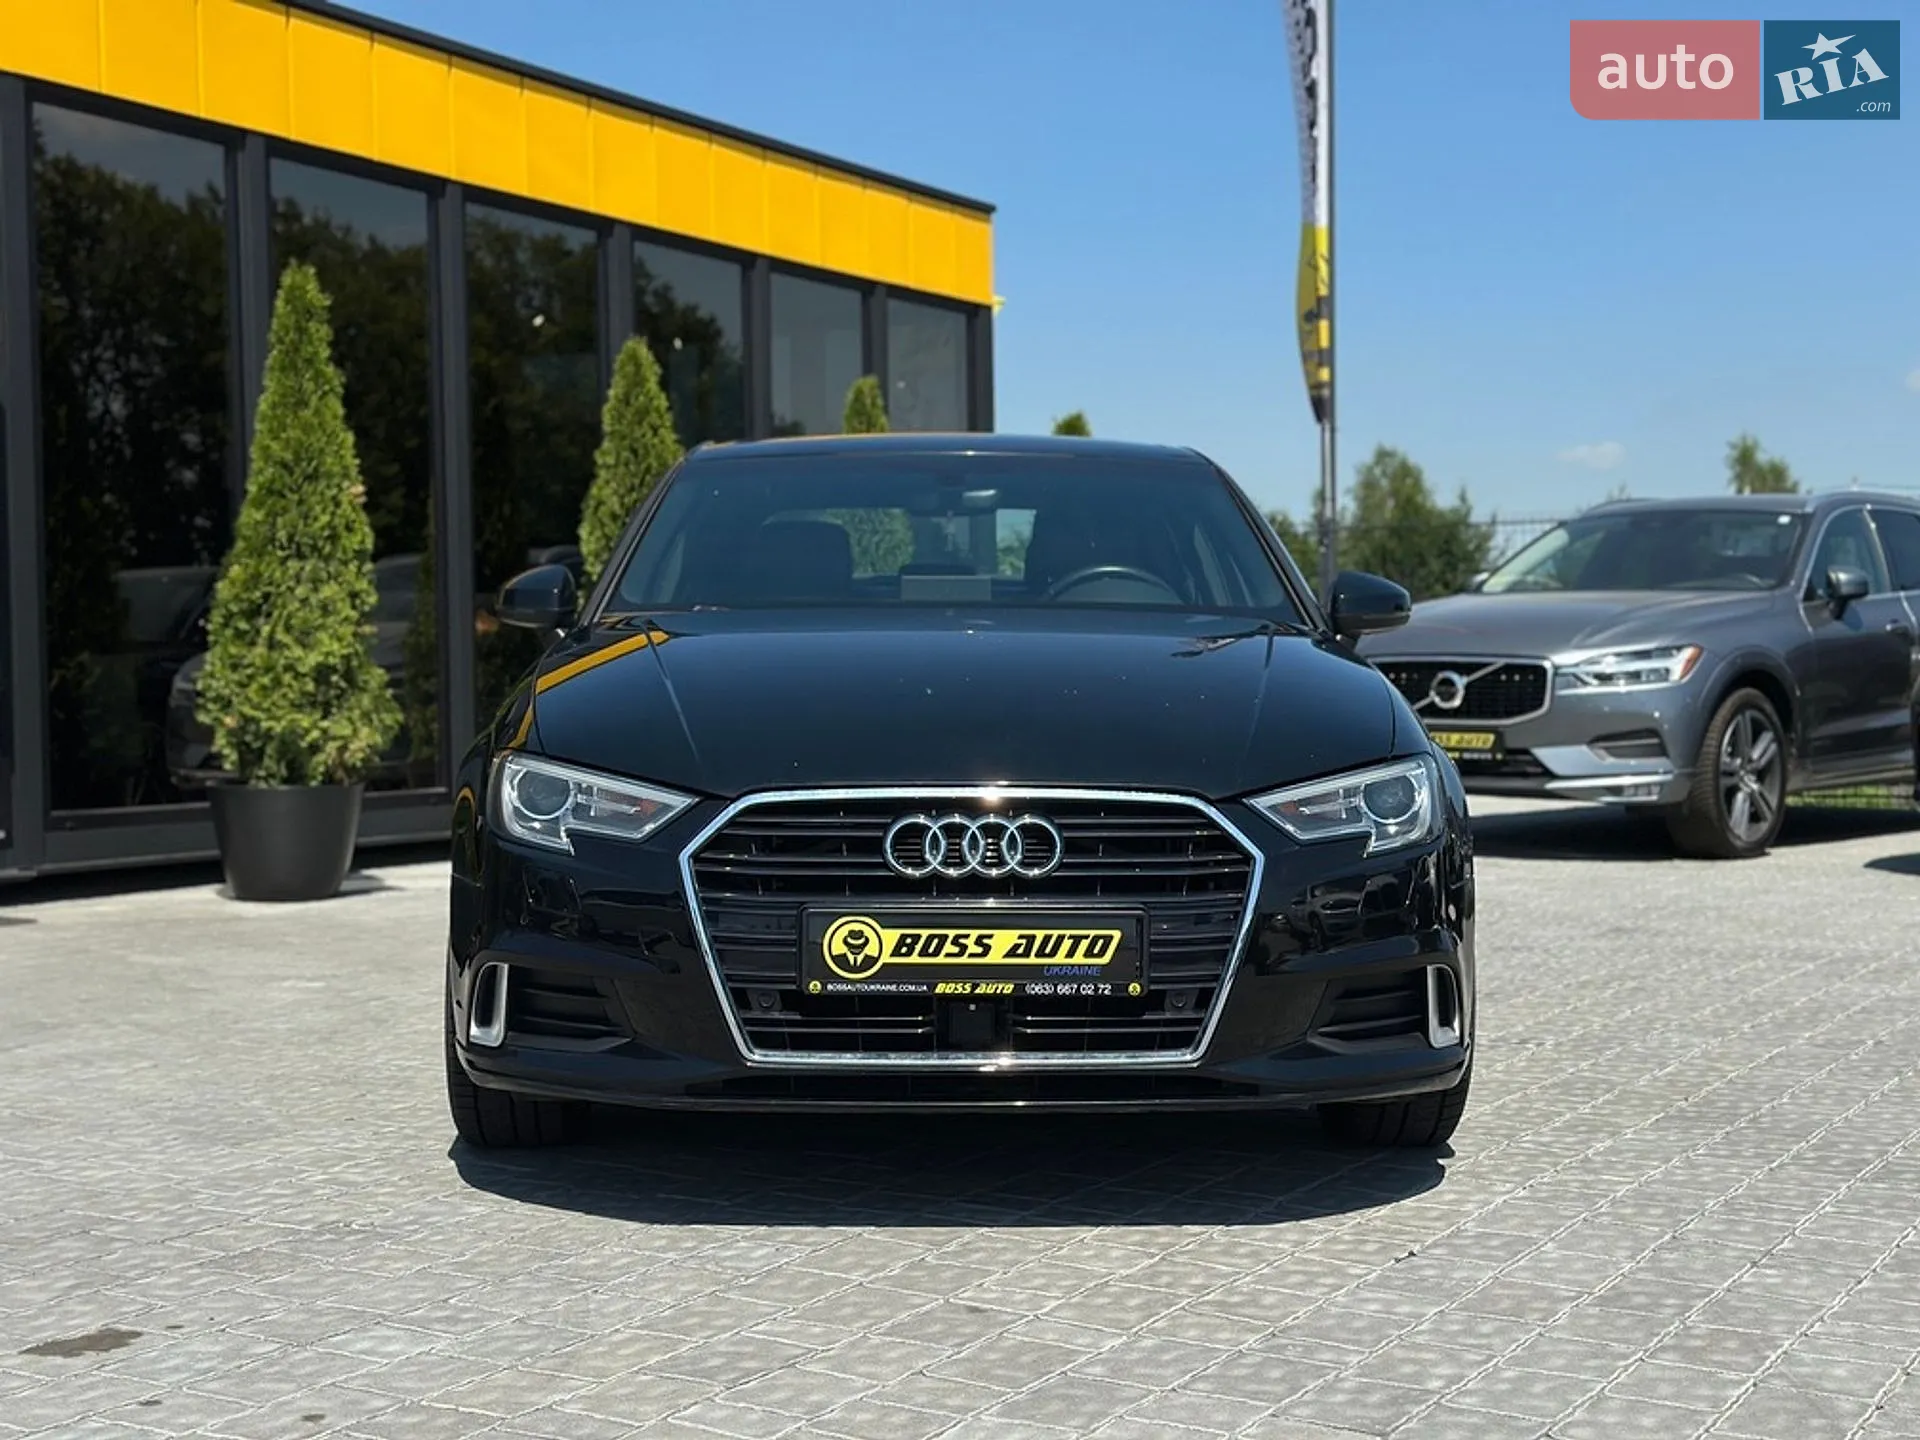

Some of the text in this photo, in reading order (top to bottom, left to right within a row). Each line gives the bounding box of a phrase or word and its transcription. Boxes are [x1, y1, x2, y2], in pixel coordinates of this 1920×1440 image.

[889, 932, 1115, 960] BOSS AUTO
[1043, 965, 1103, 977] UKRAINE
[934, 982, 1015, 994] BOSS AUTO
[1025, 982, 1055, 996] (063)
[1080, 982, 1095, 995] 02
[1097, 982, 1112, 995] 72
